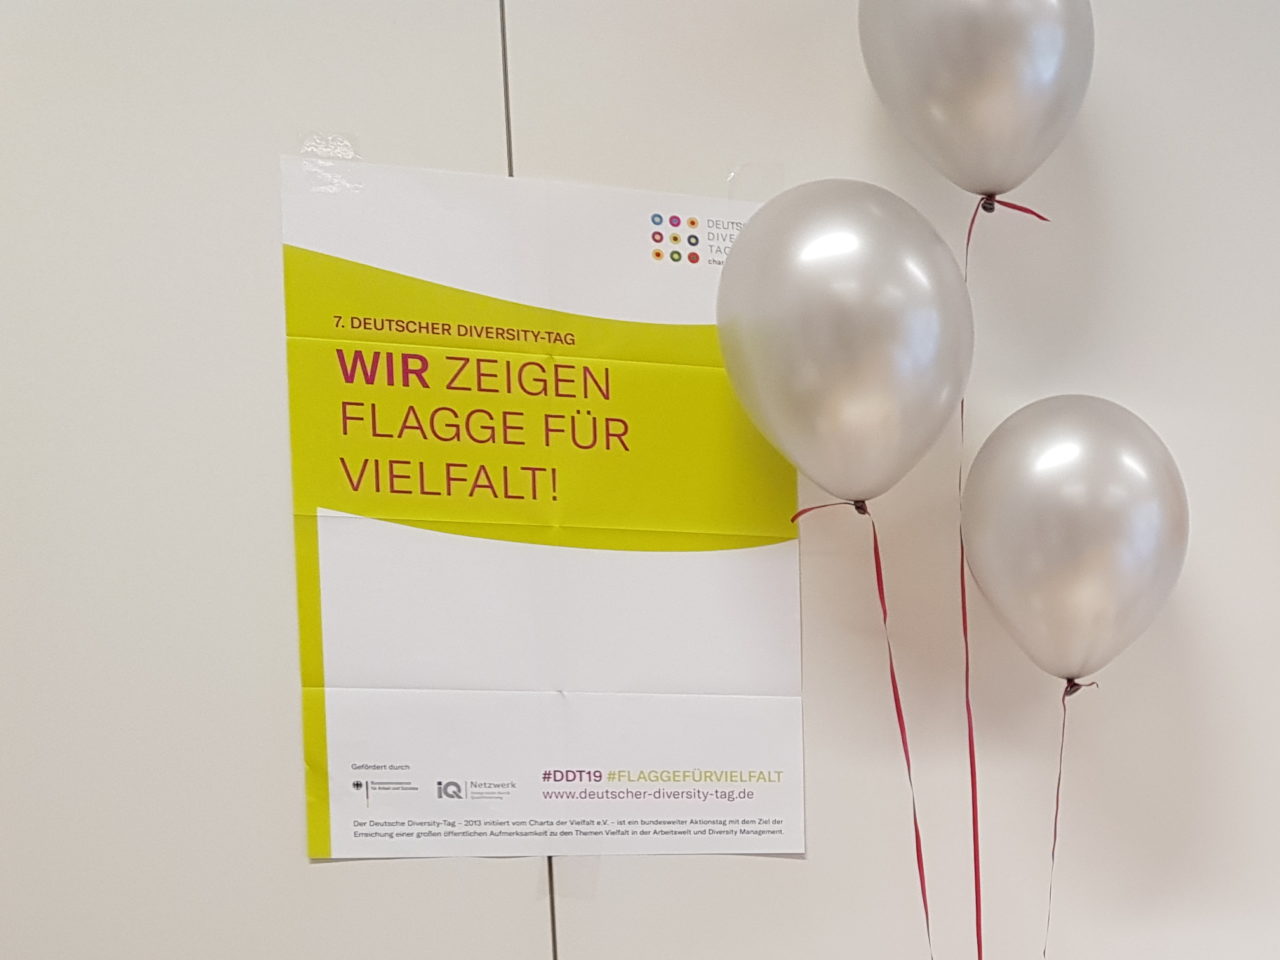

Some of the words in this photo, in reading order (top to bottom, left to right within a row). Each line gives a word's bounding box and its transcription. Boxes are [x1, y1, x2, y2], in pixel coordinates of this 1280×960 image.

[707, 219, 744, 231] DEUTS
[333, 315, 345, 330] 7.
[350, 317, 452, 336] DEUTSCHER
[457, 324, 576, 345] DIVERSITY-TAG
[336, 349, 430, 389] WIR
[445, 356, 611, 401] ZEIGEN
[341, 401, 525, 446] FLAGGE
[544, 410, 630, 451] FÜR
[339, 457, 558, 501] VIELFALT!
[542, 769, 602, 783] #DDT19
[607, 767, 784, 783] #FLAGGEFÜRVIELFALT
[436, 780, 464, 799] iQ
[470, 780, 517, 789] Netzwerk
[542, 788, 754, 802] www.deutscher-diversity-tag.de
